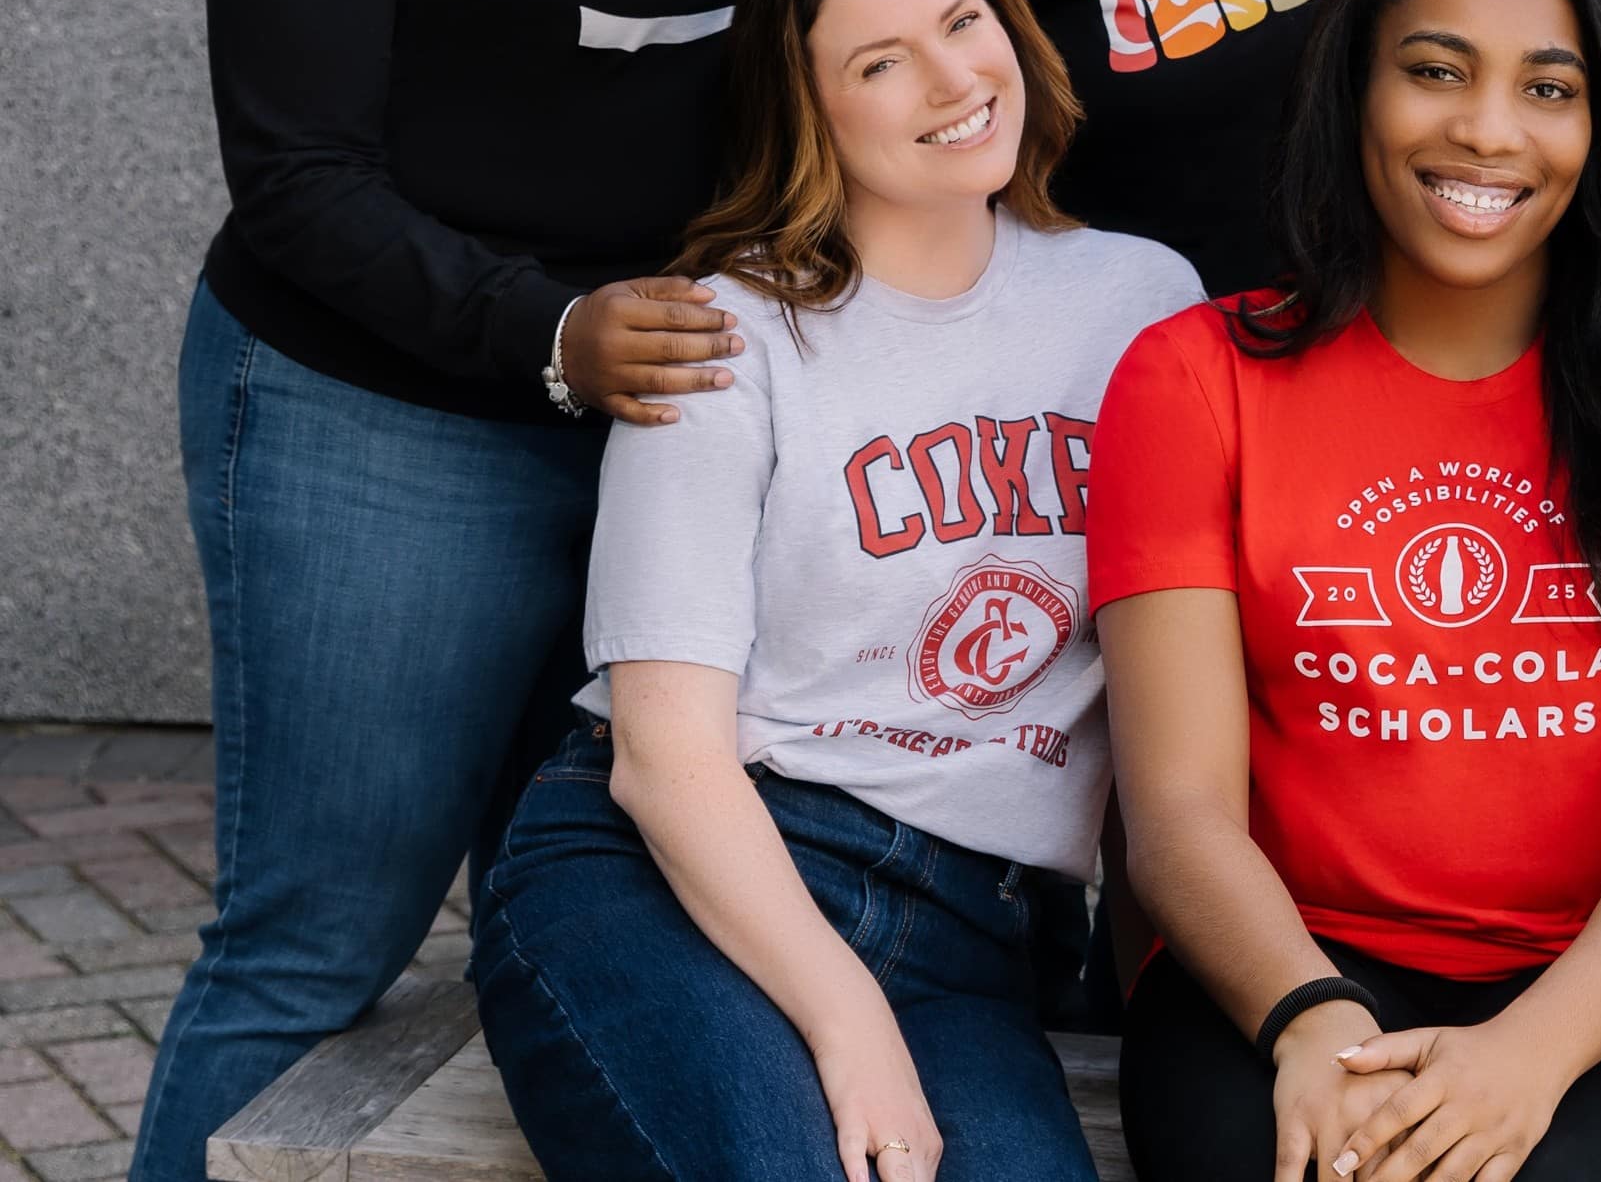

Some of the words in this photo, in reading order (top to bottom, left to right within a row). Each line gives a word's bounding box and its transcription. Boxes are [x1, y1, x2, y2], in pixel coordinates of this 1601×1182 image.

[1337, 477, 1395, 529] OPEN
[1409, 467, 1424, 482] A
[1439, 462, 1532, 495] WORLD
[1539, 499, 1565, 526] OF
[1363, 485, 1538, 535] POSSIBILITIES
[1016, 578, 1070, 632] AUTHENTIC
[1327, 587, 1356, 601] 20
[1547, 585, 1575, 599] 25
[855, 645, 897, 663] SINCE
[1318, 702, 1596, 741] SCHOLARS
